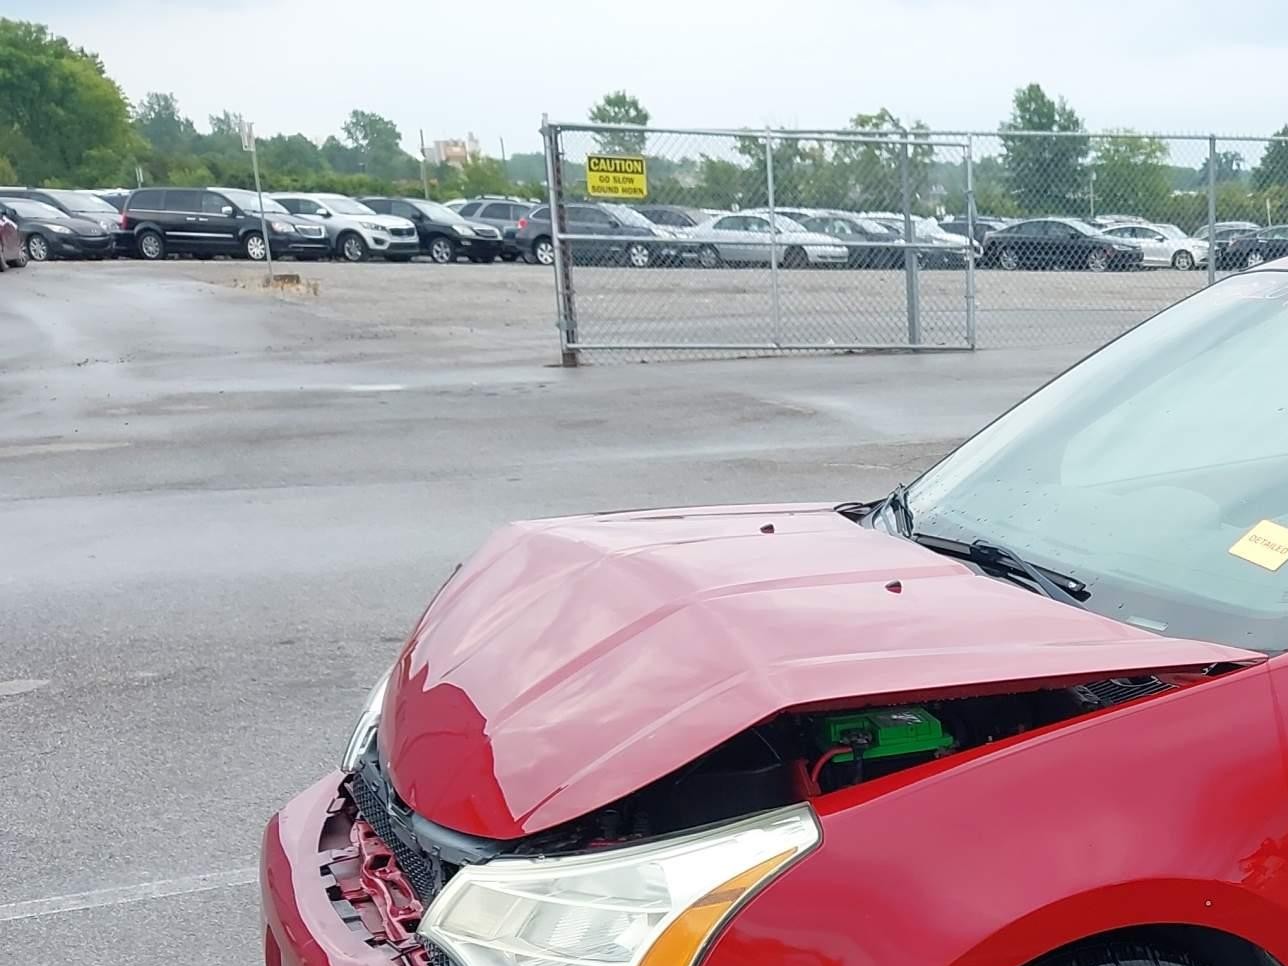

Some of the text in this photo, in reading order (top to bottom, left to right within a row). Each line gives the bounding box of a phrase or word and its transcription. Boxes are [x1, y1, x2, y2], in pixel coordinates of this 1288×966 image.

[589, 158, 642, 173] CAUTION
[598, 175, 635, 185] GO SLOW
[591, 185, 644, 196] SOUND HORN
[1248, 534, 1288, 555] DETAILED
